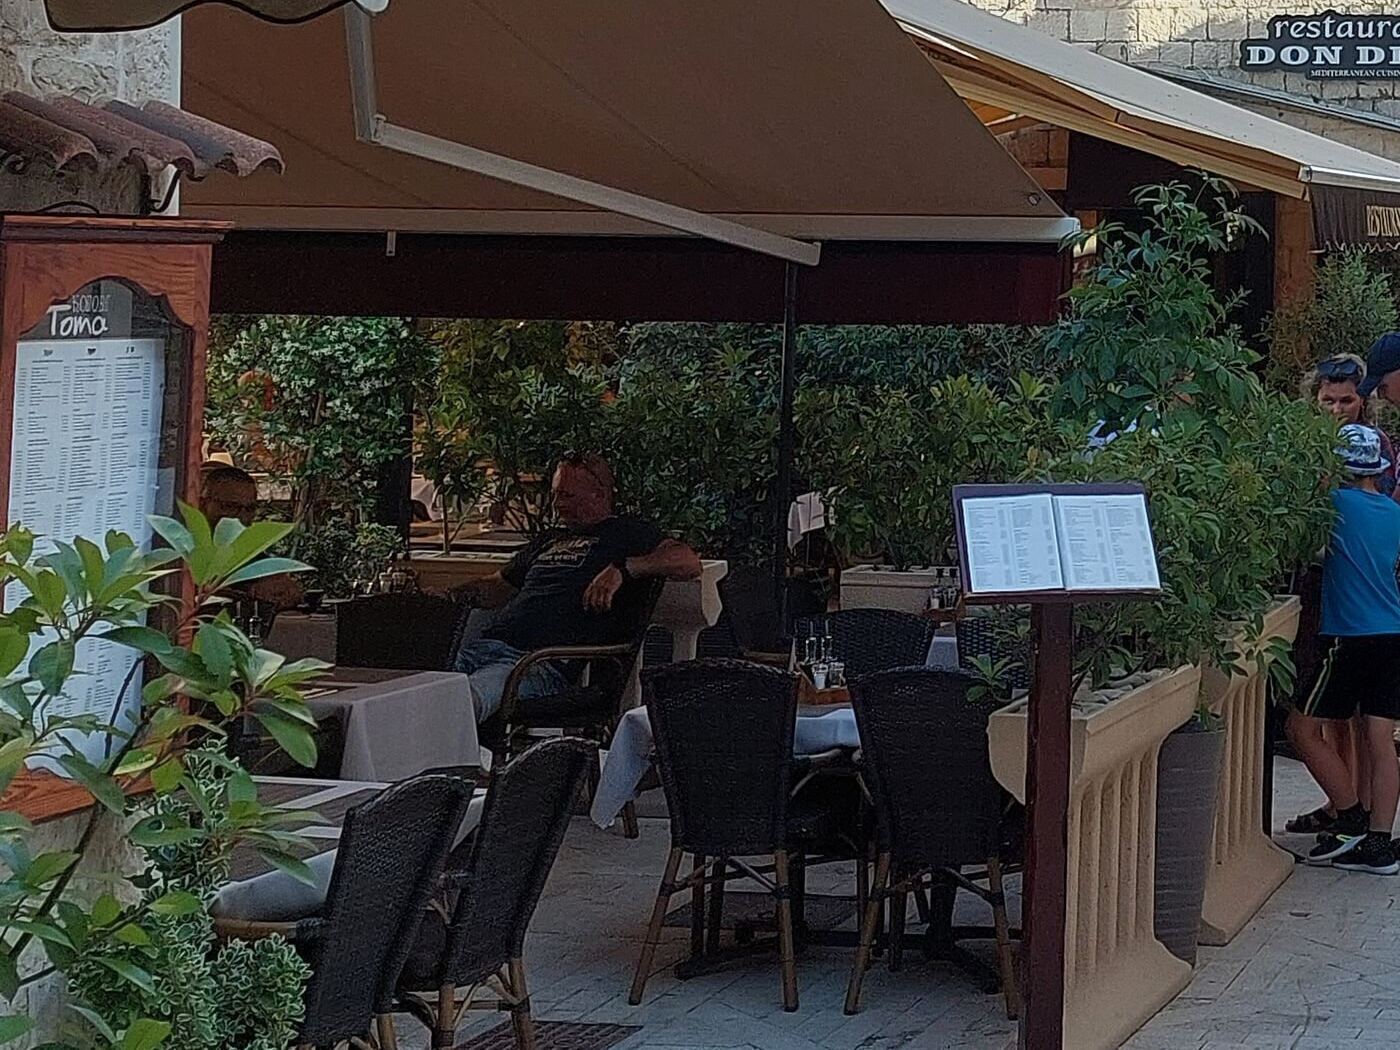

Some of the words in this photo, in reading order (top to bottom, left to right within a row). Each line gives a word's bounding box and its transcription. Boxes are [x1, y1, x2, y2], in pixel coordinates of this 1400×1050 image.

[1246, 45, 1343, 66] DON
[1310, 69, 1376, 77] MEDITERRANEAN
[46, 304, 108, 336] Toma
